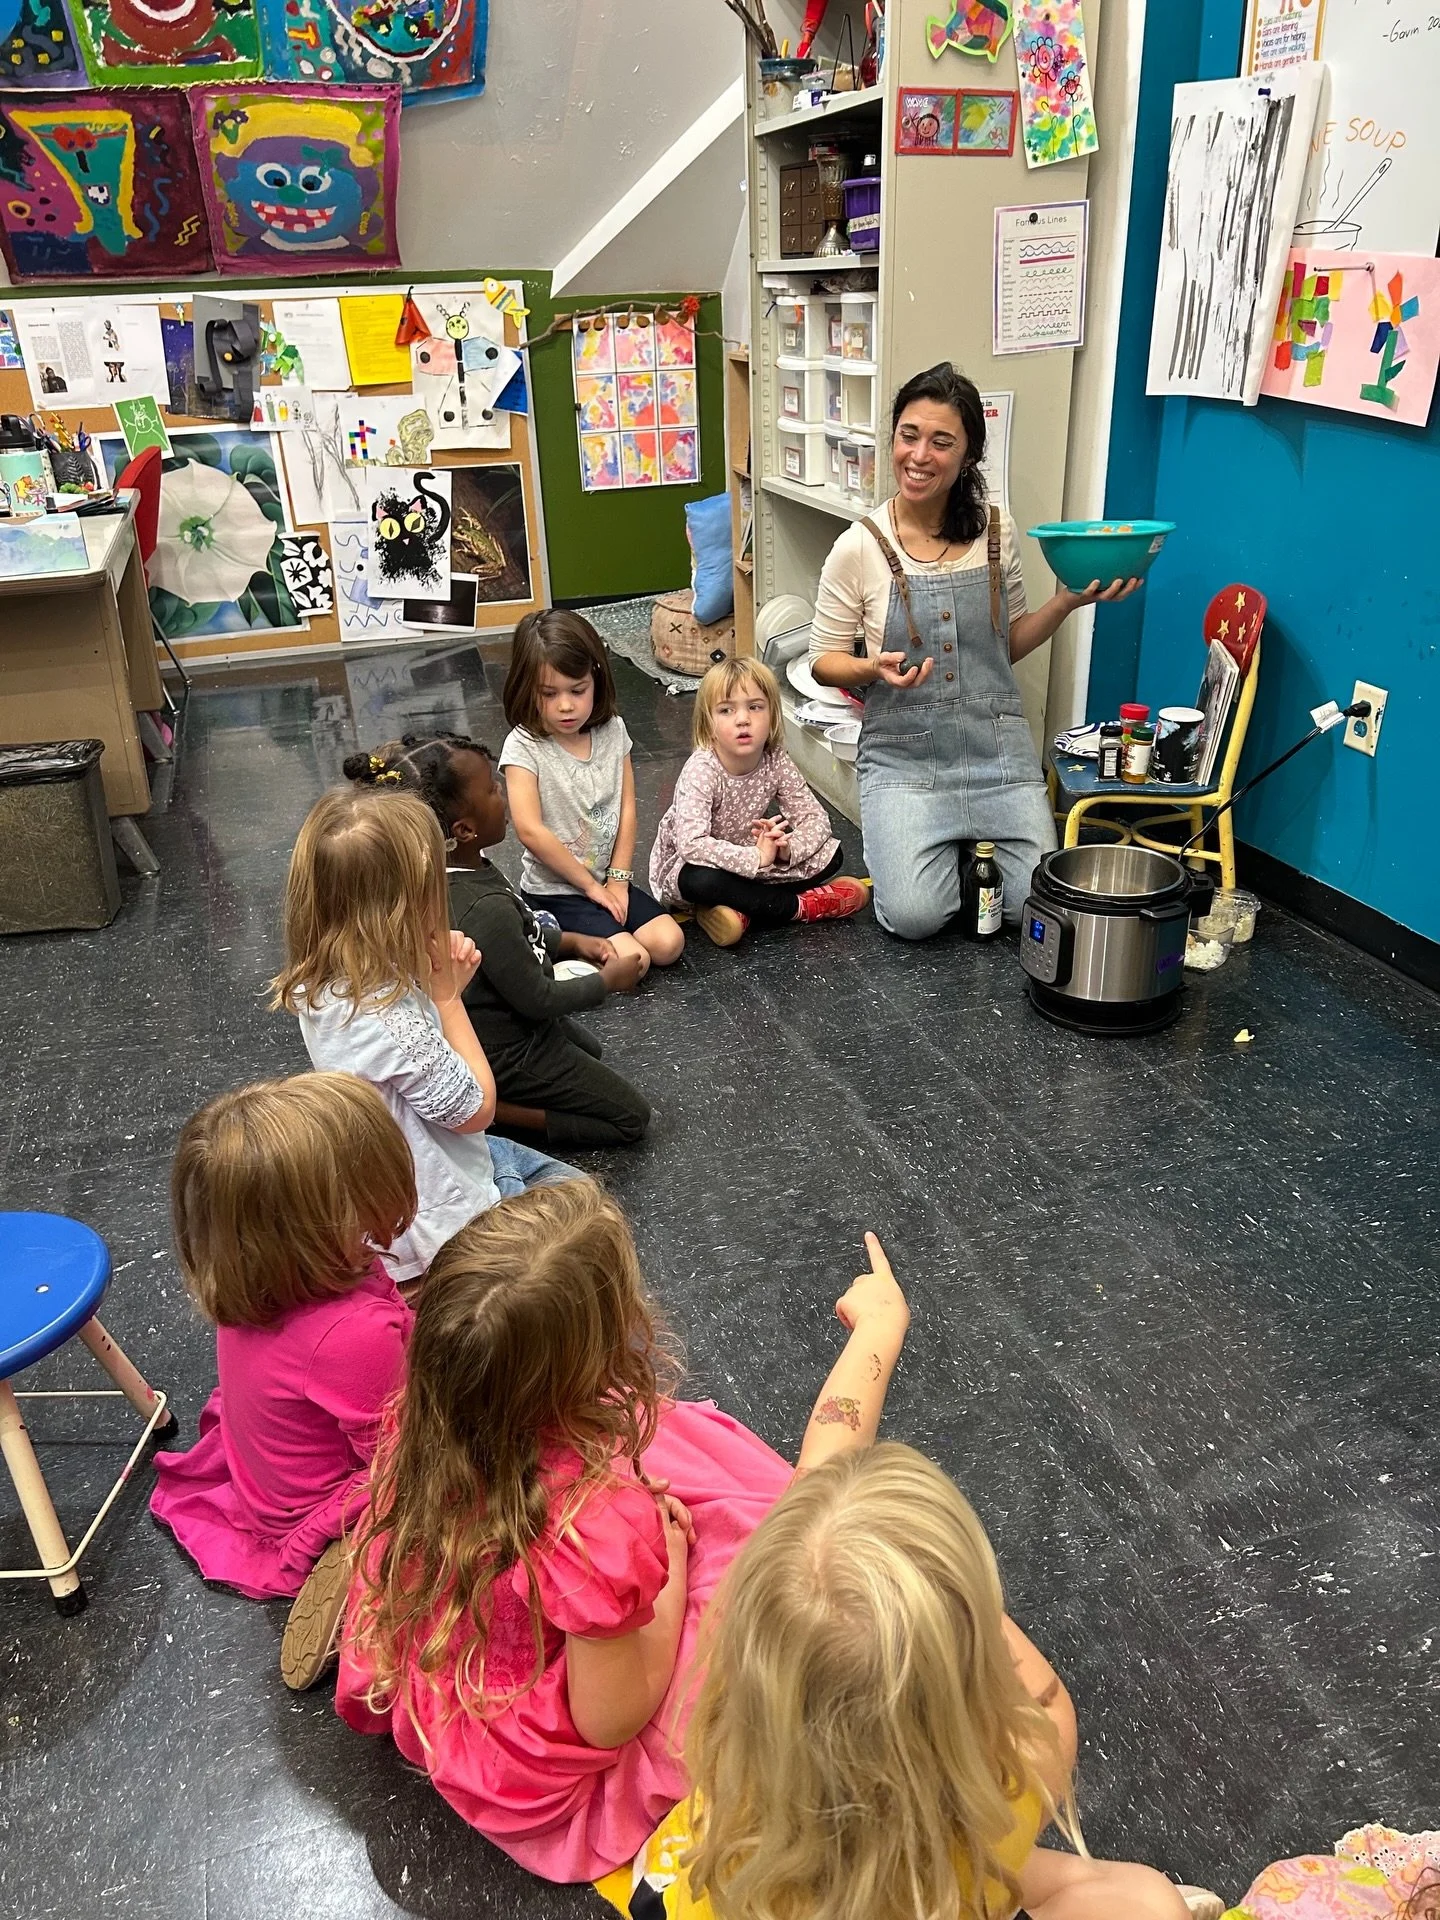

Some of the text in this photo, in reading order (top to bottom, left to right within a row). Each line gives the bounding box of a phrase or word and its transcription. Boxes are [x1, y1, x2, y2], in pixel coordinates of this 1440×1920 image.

[1428, 16, 1440, 30] 20
[1274, 37, 1282, 45] are
[1291, 31, 1307, 44] helping
[1345, 117, 1406, 153] SOUP
[1047, 215, 1068, 224] Lines
